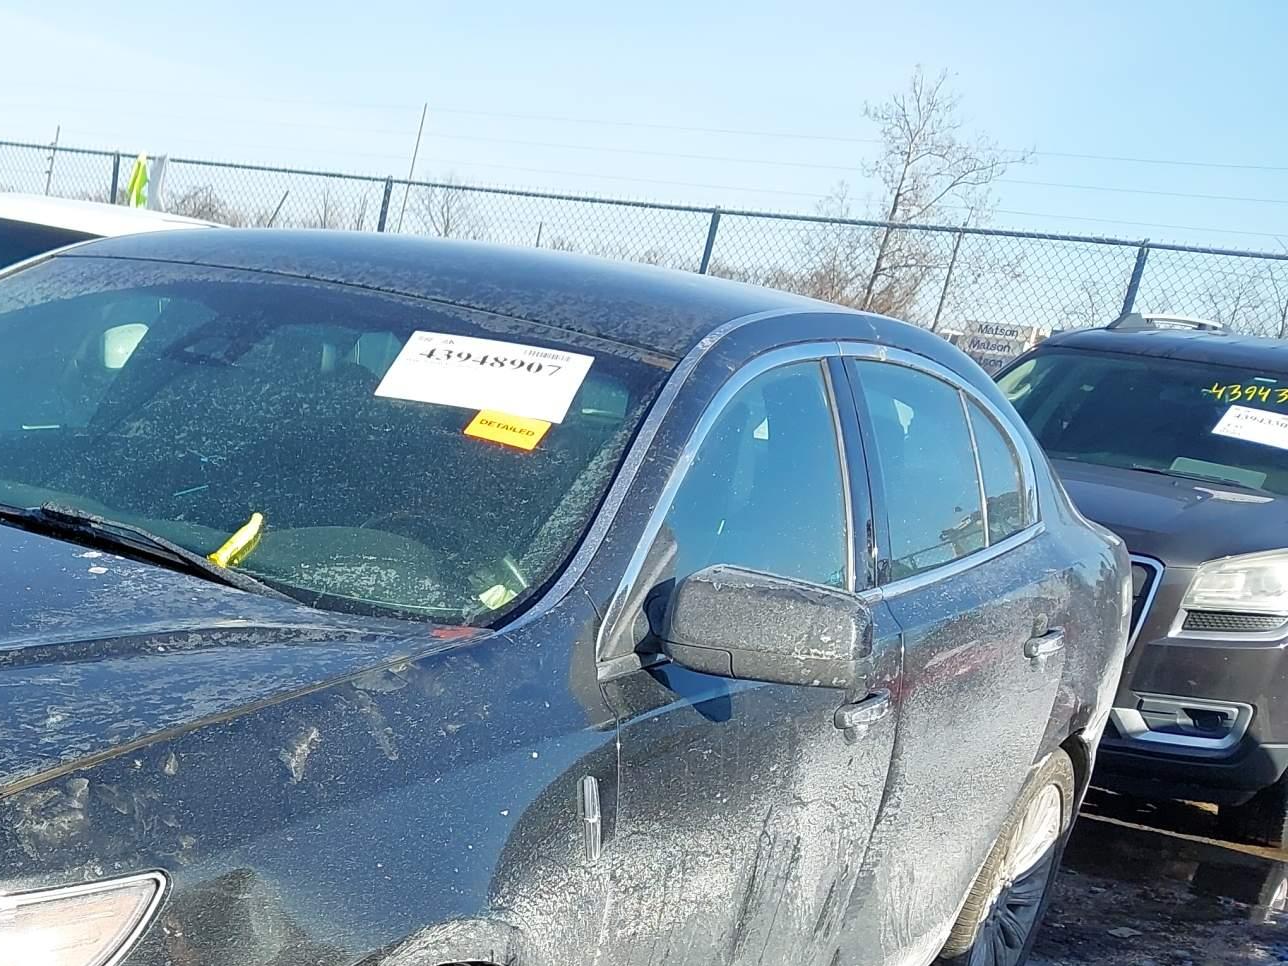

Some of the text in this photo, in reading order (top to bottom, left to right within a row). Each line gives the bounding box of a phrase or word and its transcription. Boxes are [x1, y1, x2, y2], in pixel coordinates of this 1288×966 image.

[977, 324, 1019, 339] Matson
[968, 339, 1011, 353] Matson
[419, 347, 563, 377] 43948907
[479, 417, 535, 437] DETAILED
